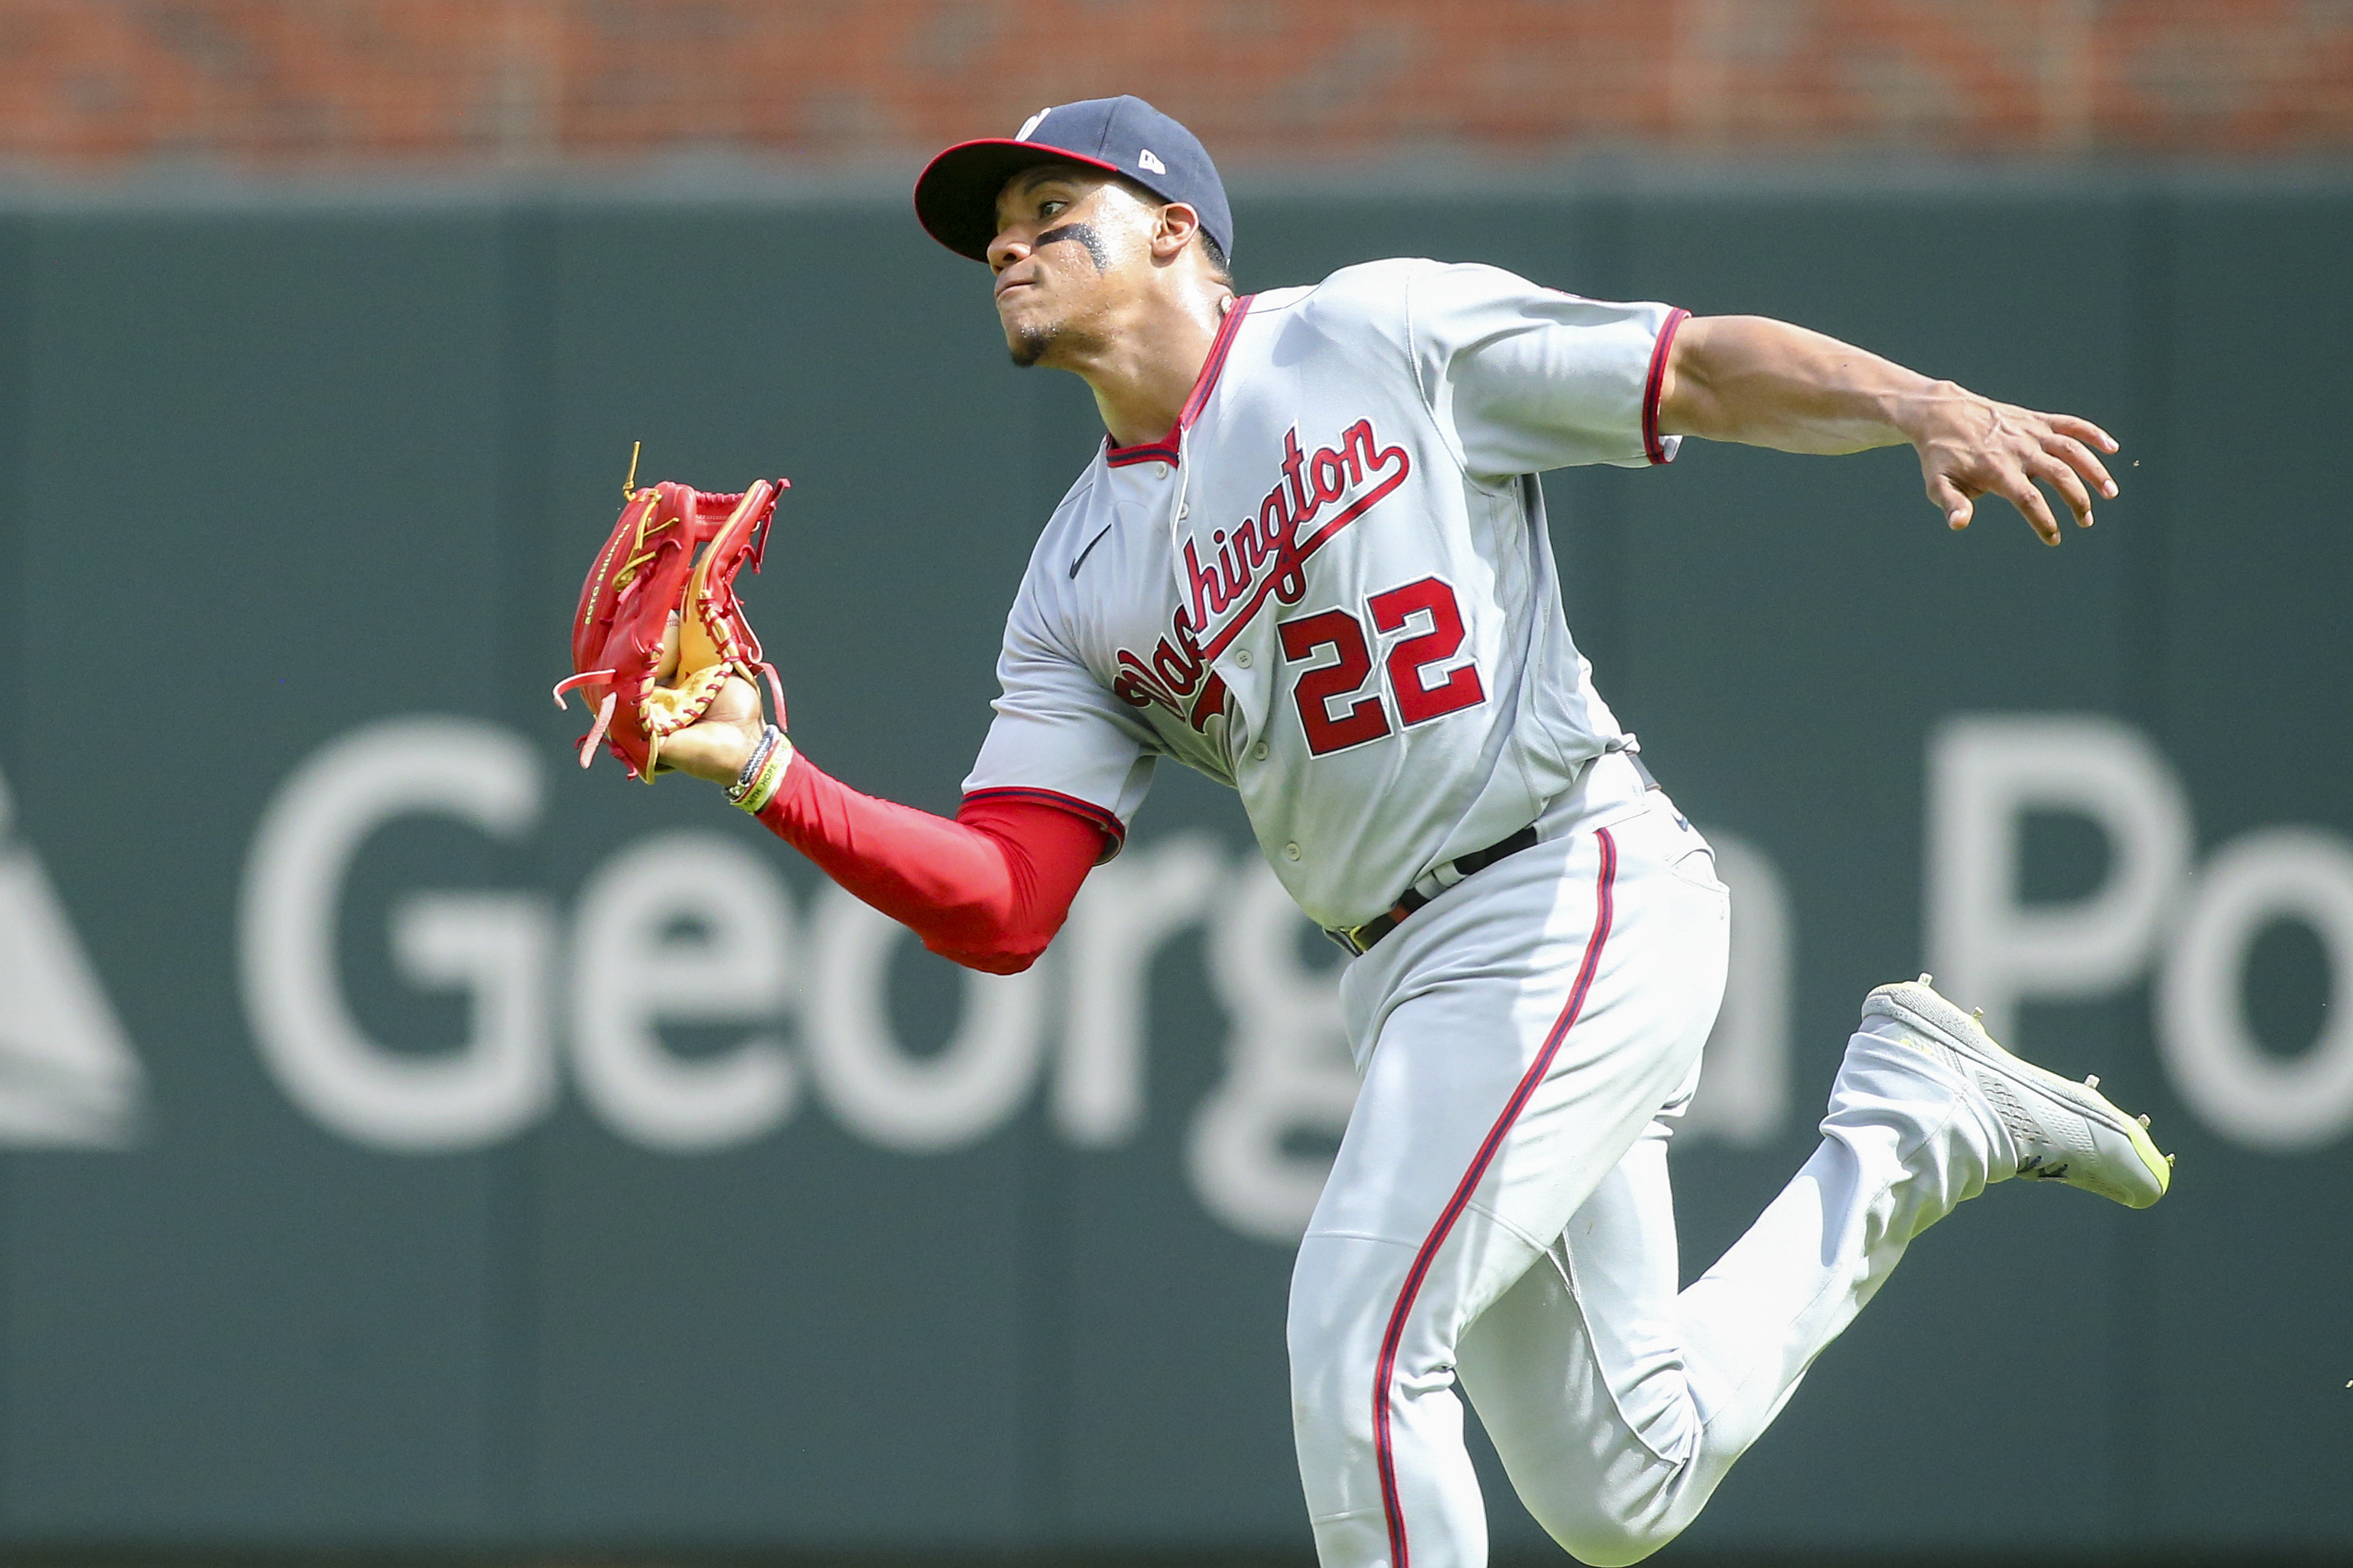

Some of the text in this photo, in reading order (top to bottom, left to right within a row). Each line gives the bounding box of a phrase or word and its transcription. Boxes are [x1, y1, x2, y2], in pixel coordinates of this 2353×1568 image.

[584, 585, 601, 625] SOTO
[1276, 572, 1493, 760] 22
[760, 763, 778, 787] HOPE
